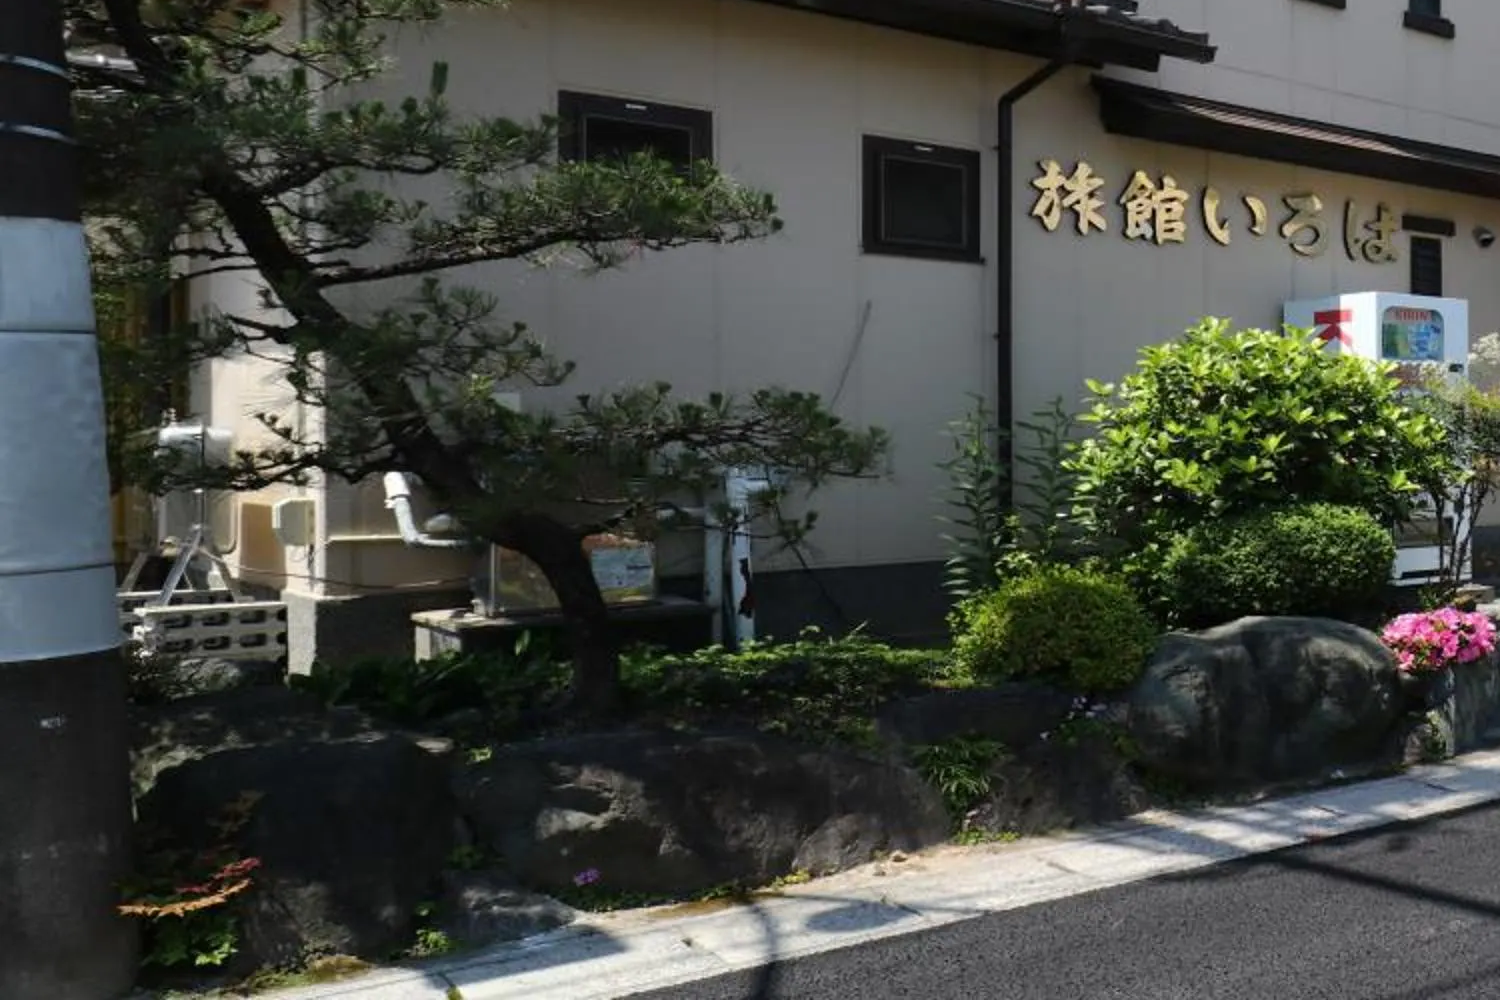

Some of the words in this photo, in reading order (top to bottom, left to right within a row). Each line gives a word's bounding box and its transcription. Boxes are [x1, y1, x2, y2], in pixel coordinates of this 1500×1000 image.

[1030, 158, 1401, 264] 旅館いろは
